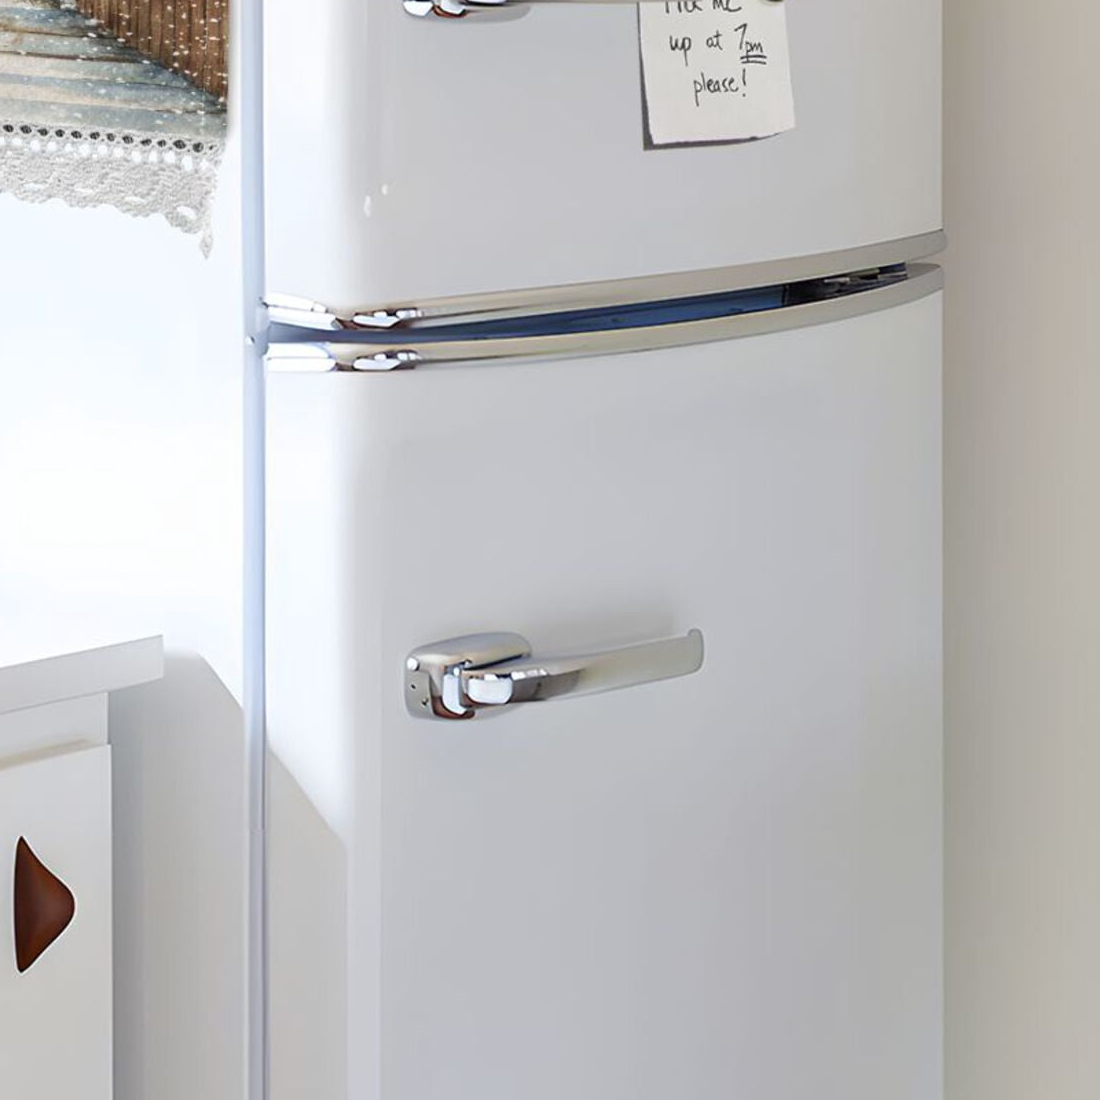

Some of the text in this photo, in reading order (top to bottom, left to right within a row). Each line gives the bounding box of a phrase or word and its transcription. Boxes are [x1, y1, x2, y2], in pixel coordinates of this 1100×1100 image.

[669, 35, 692, 67] up
[706, 30, 723, 51] at
[693, 68, 747, 107] please!
